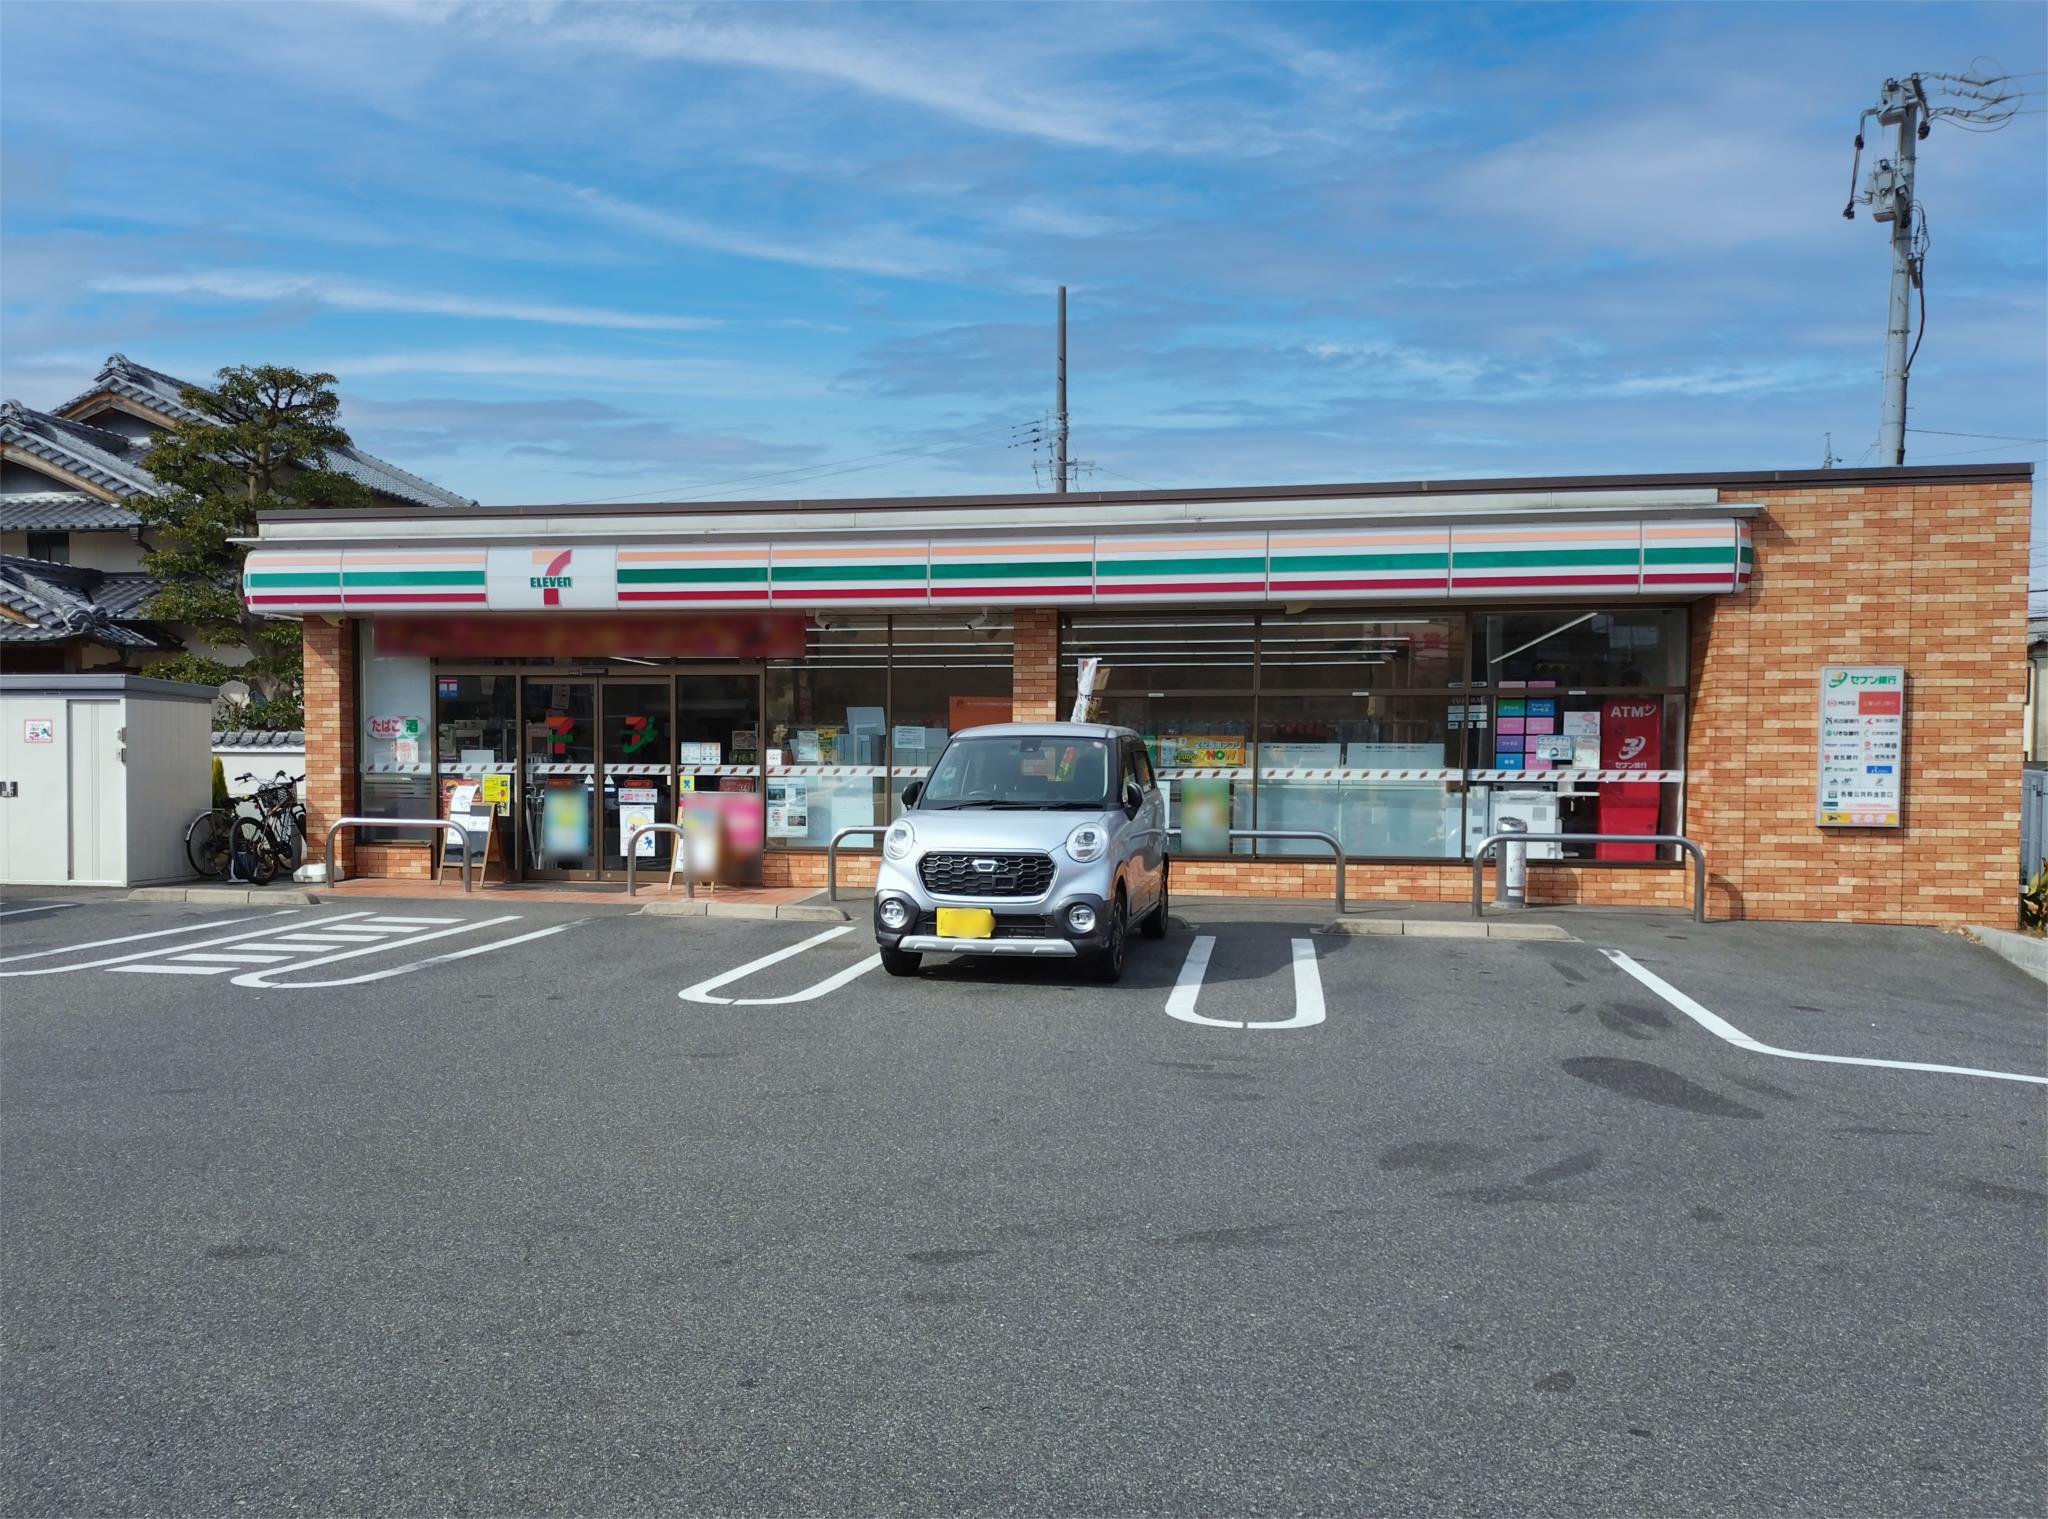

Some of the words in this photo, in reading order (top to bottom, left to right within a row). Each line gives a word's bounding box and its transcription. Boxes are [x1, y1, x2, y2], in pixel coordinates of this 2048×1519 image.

[1851, 675, 1897, 685] セブン銀行
[371, 719, 401, 733] たばこ
[405, 719, 419, 733] 酒
